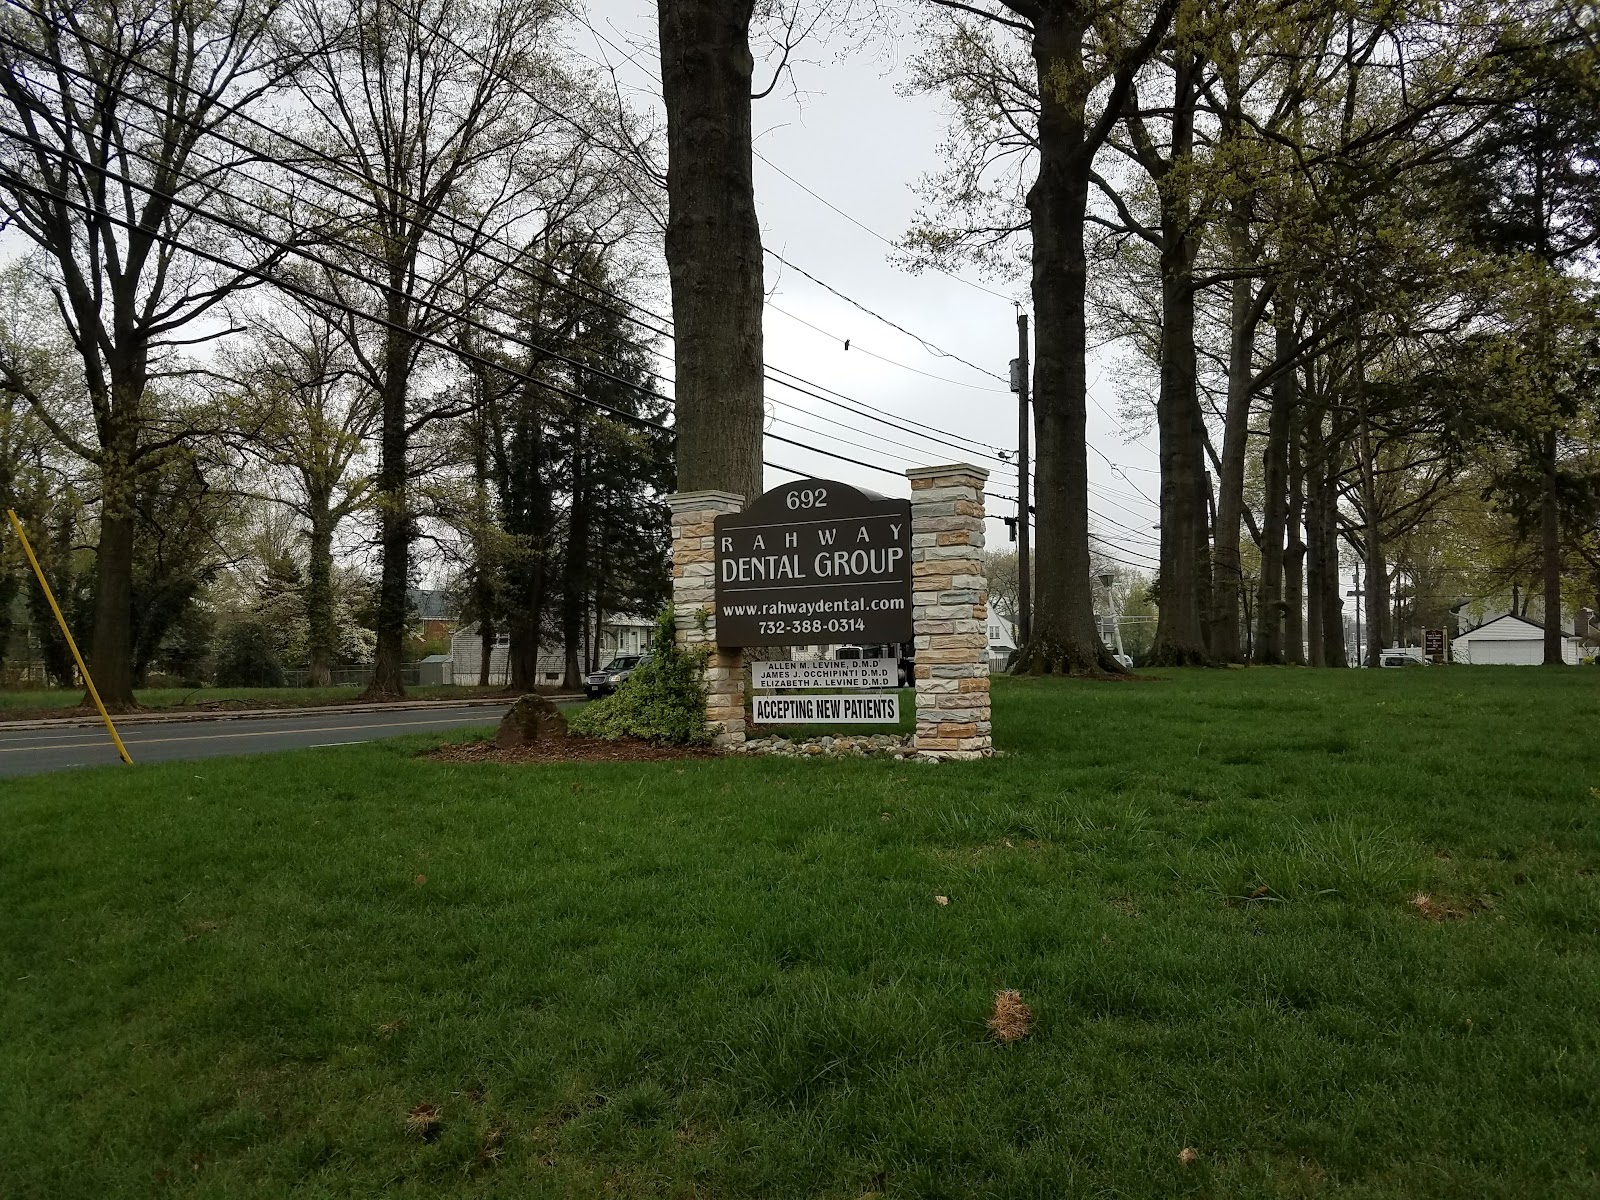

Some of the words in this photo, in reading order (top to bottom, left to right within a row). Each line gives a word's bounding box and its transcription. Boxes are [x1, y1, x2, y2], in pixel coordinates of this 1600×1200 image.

[786, 488, 828, 510] 692
[721, 523, 902, 553] RAHWAY
[722, 554, 806, 583] DENTAL
[814, 547, 904, 577] GROUP
[723, 597, 905, 616] www.rahwaydental.com
[759, 617, 865, 635] 732-388-0314
[761, 671, 790, 679] JAMES
[803, 670, 858, 678] OCCHIPINTI
[861, 669, 888, 677] D.M.D
[768, 662, 796, 670] ALLEN
[812, 661, 849, 669] LEVINE,
[852, 660, 879, 668] D.M.D
[760, 679, 810, 687] ELIZABETH
[813, 679, 822, 687] A.
[825, 678, 859, 686] LEVINE
[862, 678, 889, 686] D.M.D
[757, 699, 814, 719] ACCEPTING
[816, 699, 841, 719] NEW
[844, 699, 895, 719] PATIENTS
